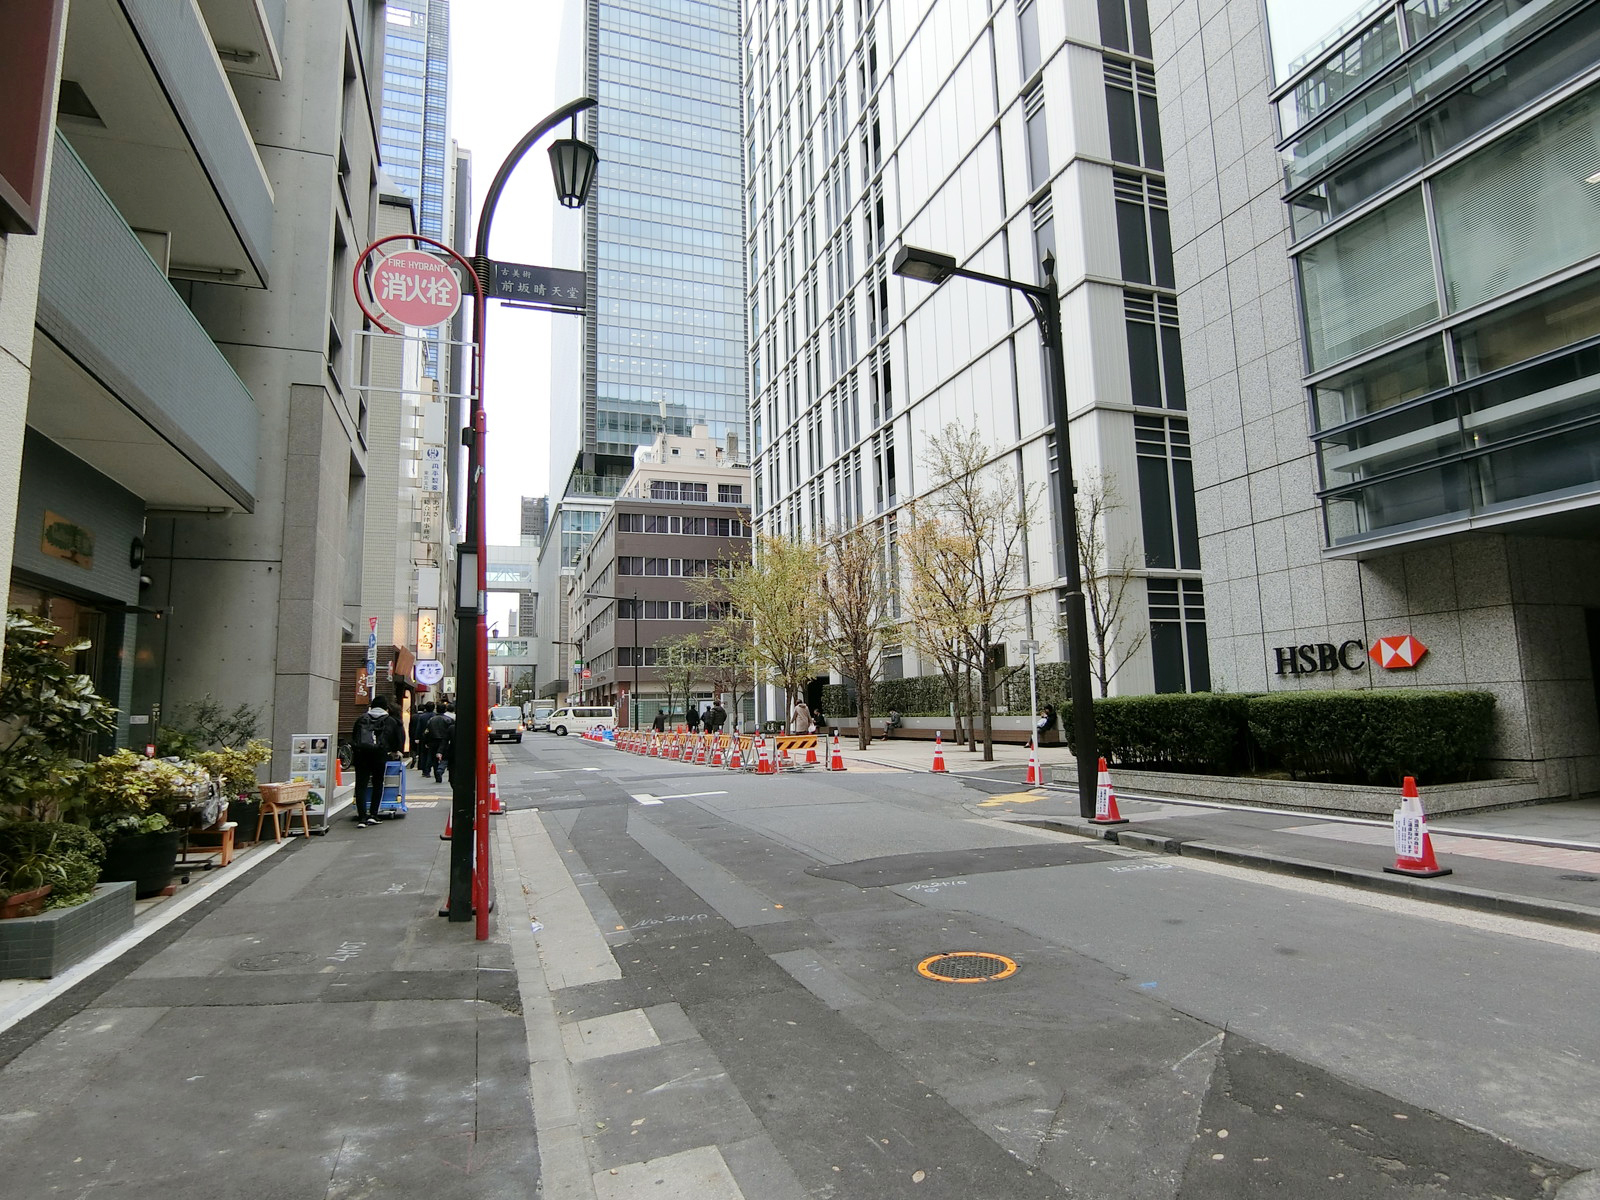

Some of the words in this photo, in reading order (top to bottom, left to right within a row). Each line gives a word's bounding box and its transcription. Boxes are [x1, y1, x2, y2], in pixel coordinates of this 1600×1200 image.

[387, 258, 406, 269] FIRE
[408, 260, 445, 273] HYDRANT
[500, 268, 532, 279] 古美術
[380, 270, 453, 308] 消火栓
[501, 280, 580, 300] 前坂晴天堂
[1273, 639, 1366, 675] HSBC
